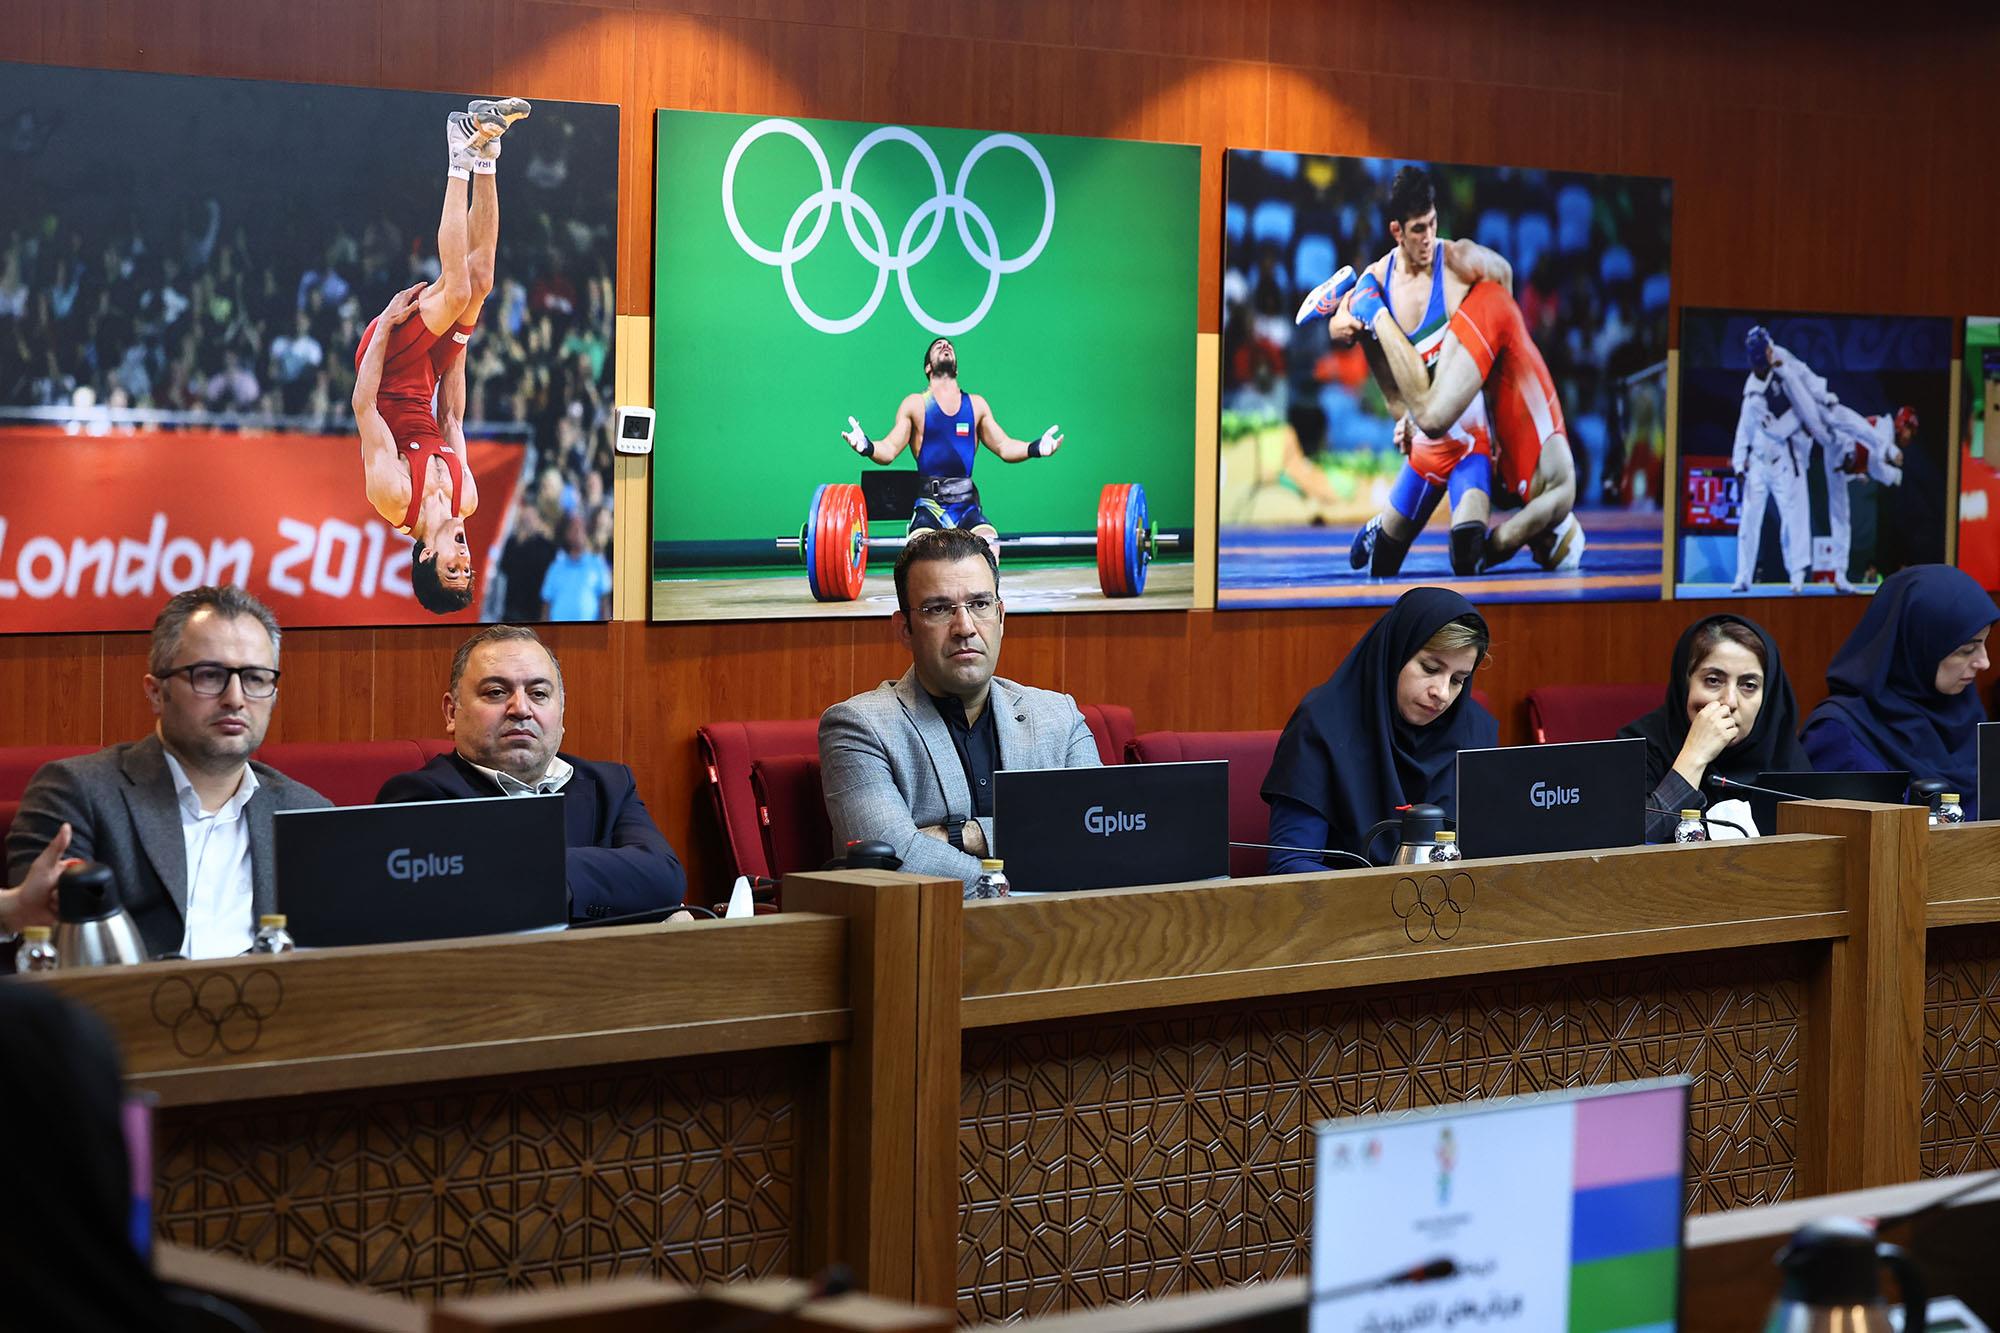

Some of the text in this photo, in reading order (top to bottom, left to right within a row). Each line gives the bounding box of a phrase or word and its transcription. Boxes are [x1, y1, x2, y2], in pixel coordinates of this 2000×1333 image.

[268, 517, 416, 597] 2012
[1530, 781, 1580, 809] Gplus
[1084, 806, 1146, 836] Gplus
[387, 848, 464, 882] Gplus
